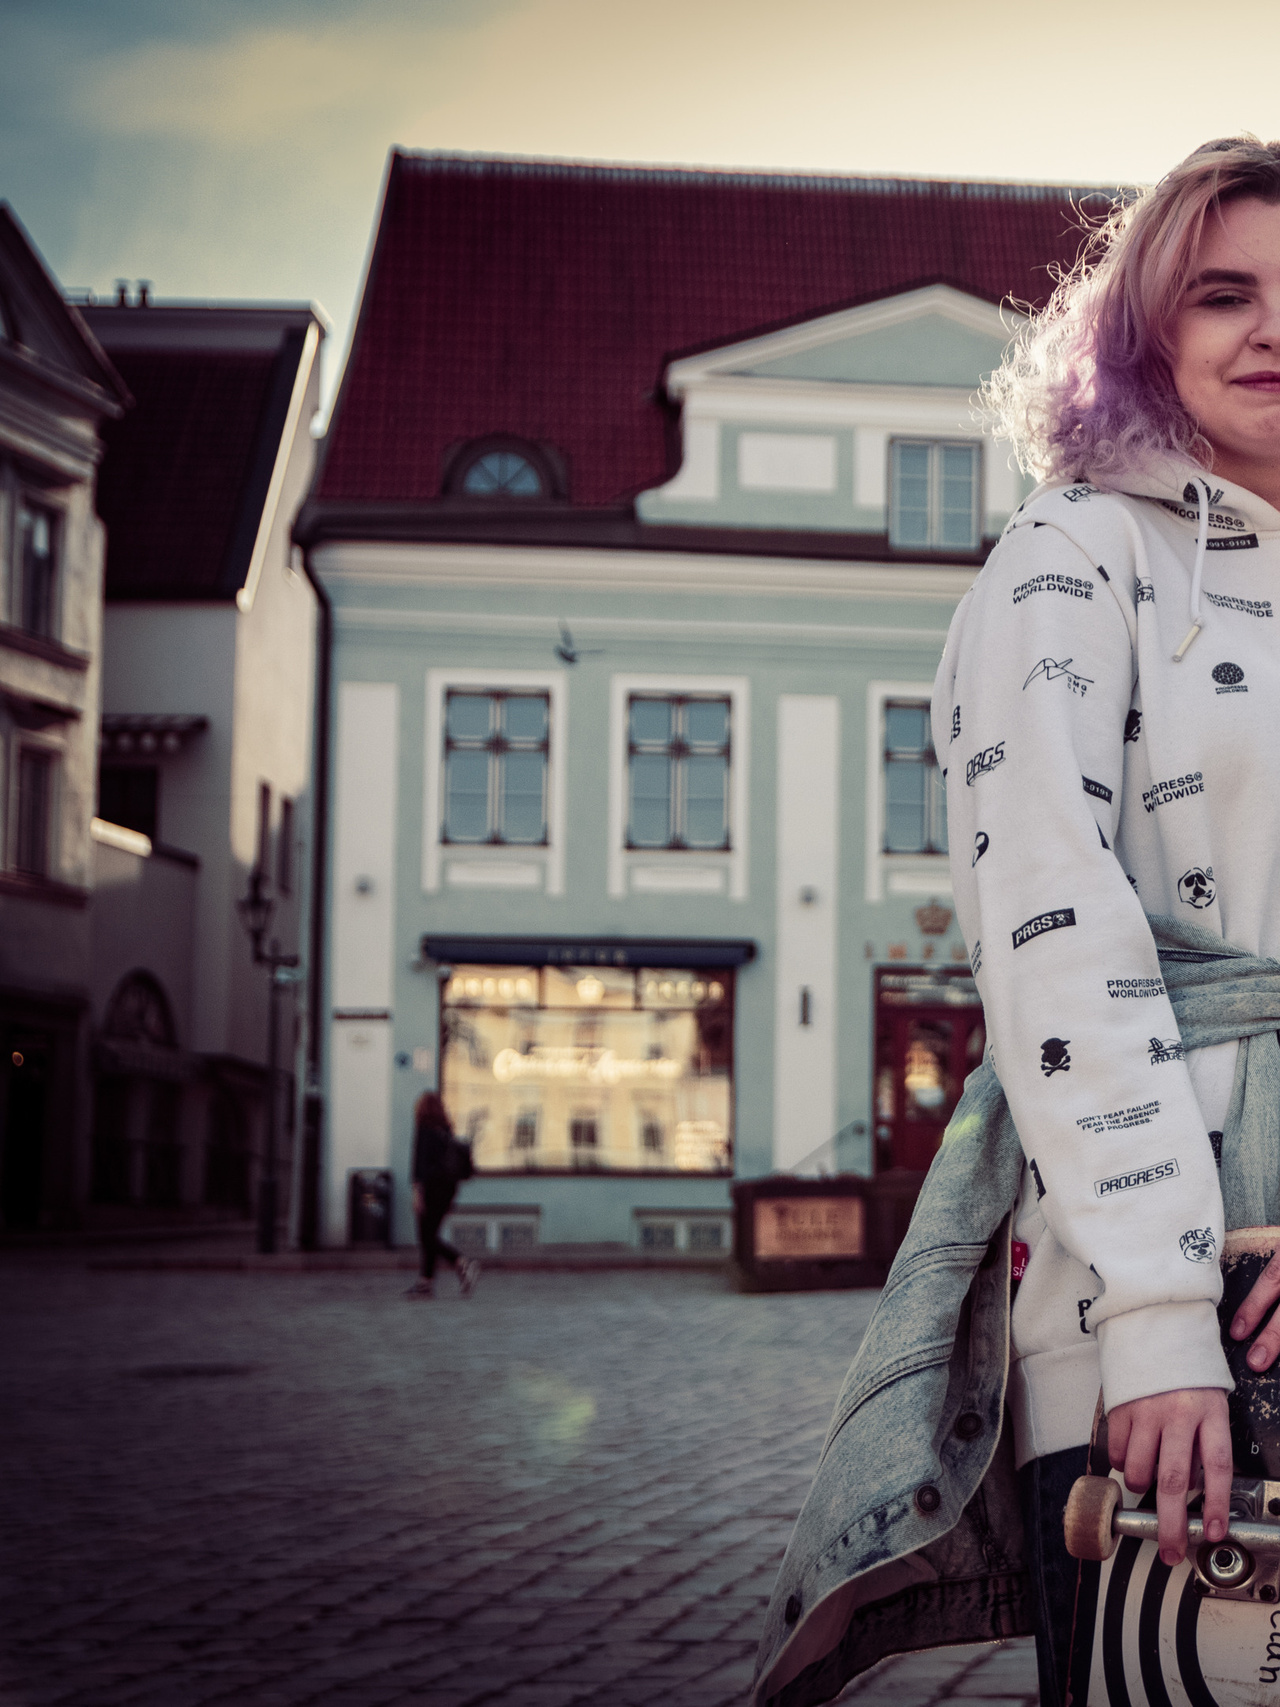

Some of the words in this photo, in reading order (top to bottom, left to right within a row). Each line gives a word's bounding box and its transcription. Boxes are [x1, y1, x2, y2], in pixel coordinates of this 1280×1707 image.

[1162, 501, 1236, 526] PROGESS
[1013, 582, 1094, 605] WORLDWIDE
[1208, 599, 1273, 618] ORLDWIDE
[966, 740, 1006, 786] PRGS
[1082, 780, 1110, 798] 1-9191
[1144, 782, 1205, 814] WLDWIDE
[1015, 914, 1053, 946] PRGS
[1107, 986, 1167, 999] WORLDWIDE
[1076, 1115, 1101, 1126] DON'T
[1103, 1110, 1125, 1120] FEAR
[1126, 1100, 1162, 1115] FAILURE.
[1082, 1120, 1104, 1131] FEAR
[1105, 1118, 1121, 1126] THE
[1122, 1107, 1161, 1123] ABSENCE
[1094, 1126, 1106, 1134] OF
[1107, 1118, 1153, 1131] PROGRESS.
[1100, 1162, 1174, 1195] PROGRESS
[1178, 1228, 1216, 1251] PRGS
